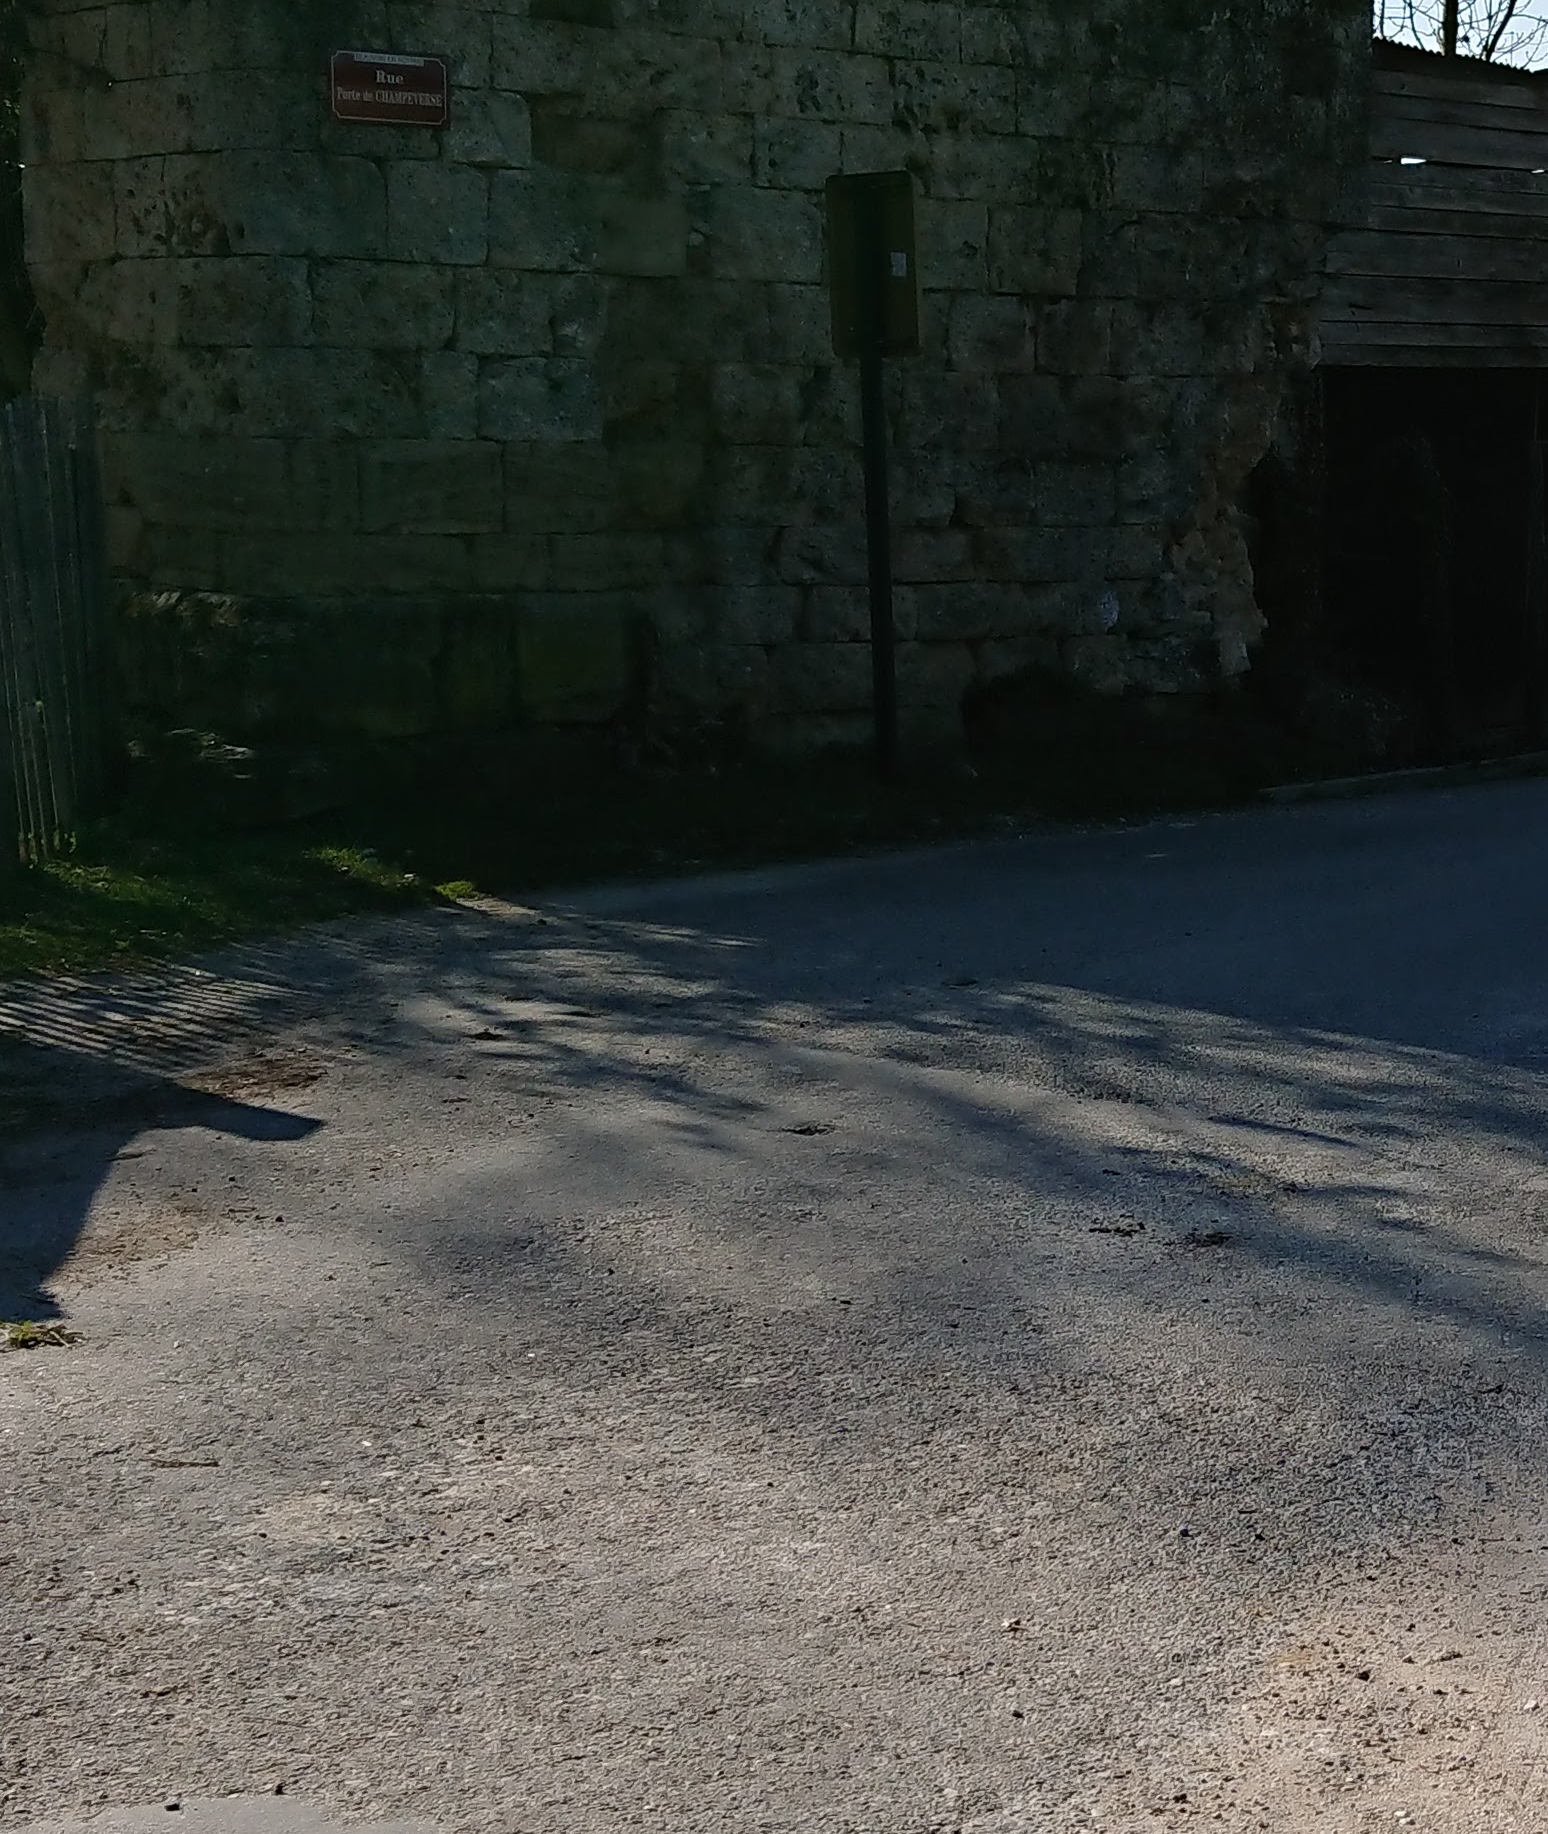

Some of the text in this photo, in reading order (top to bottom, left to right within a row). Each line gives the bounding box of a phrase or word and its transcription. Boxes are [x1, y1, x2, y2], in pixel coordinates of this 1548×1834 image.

[375, 69, 404, 85] Rue
[336, 86, 361, 102] Porte
[362, 89, 373, 102] de
